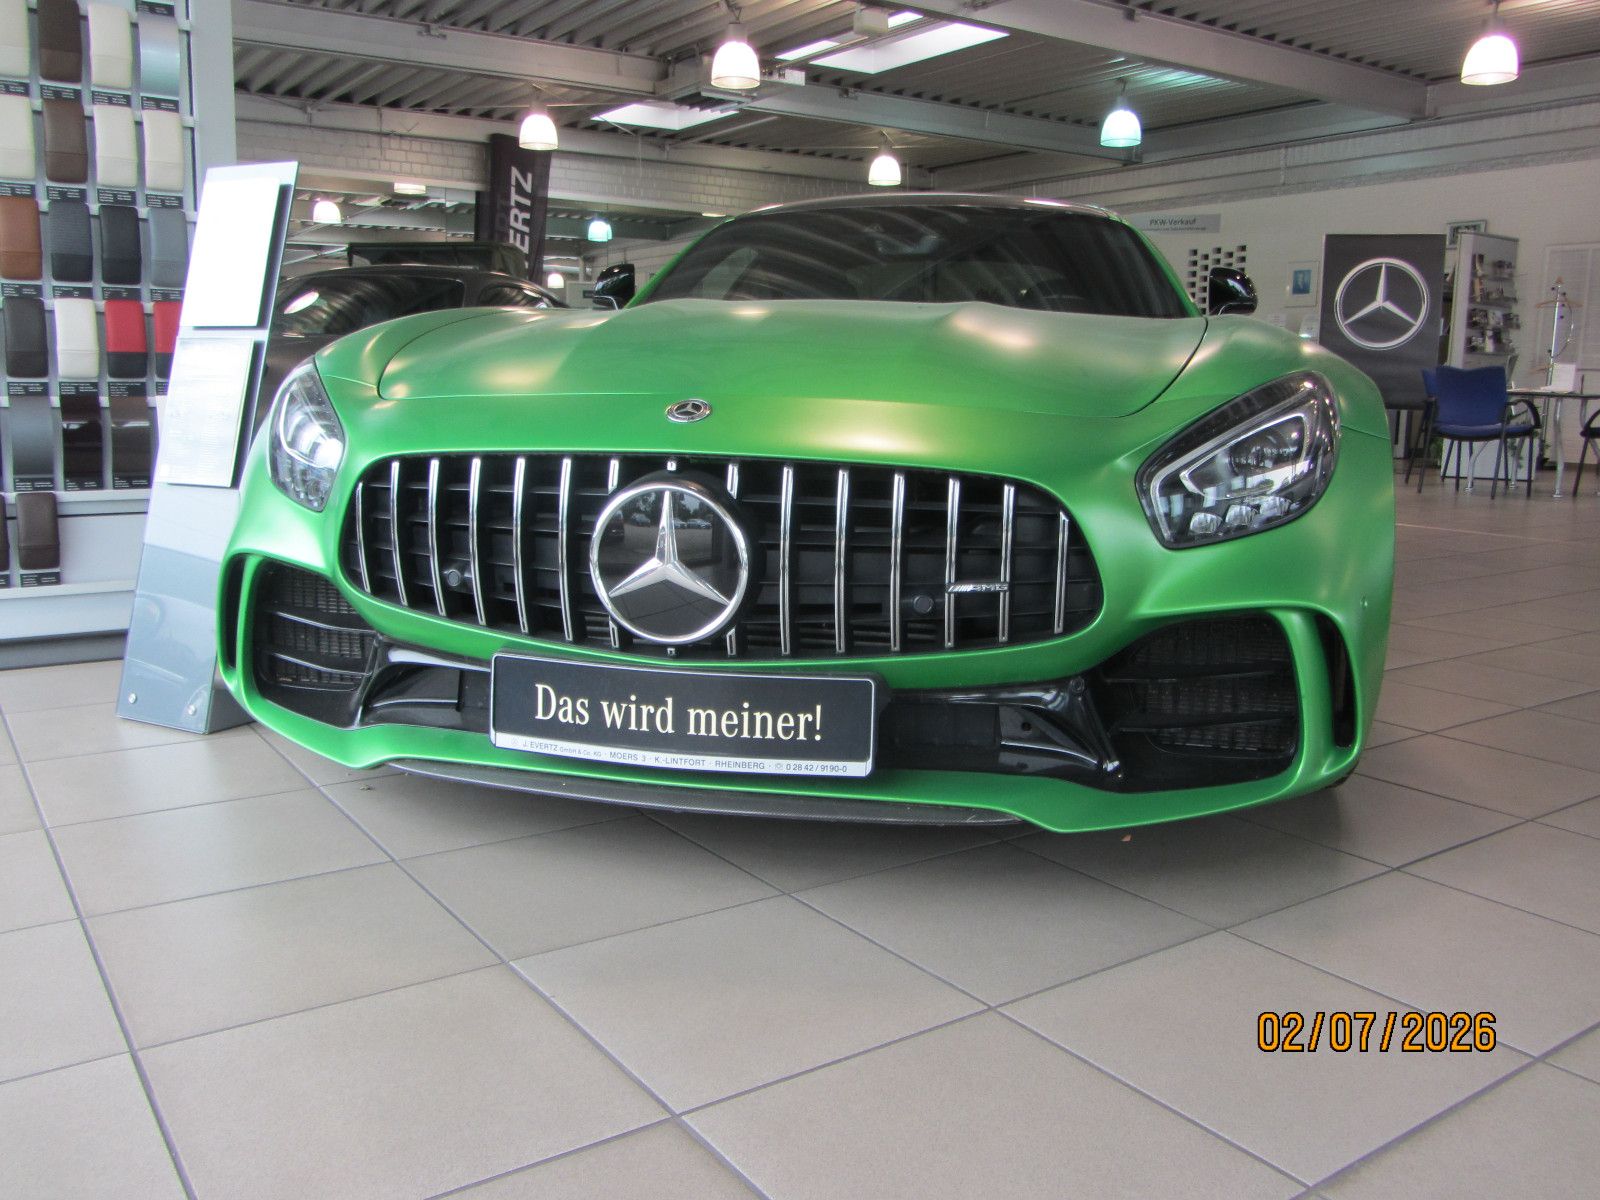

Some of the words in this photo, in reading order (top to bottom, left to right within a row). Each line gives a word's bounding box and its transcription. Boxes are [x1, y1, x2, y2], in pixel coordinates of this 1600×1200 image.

[509, 165, 533, 269] ERTZ
[535, 683, 590, 725] Das
[601, 695, 675, 734] wird
[687, 702, 822, 741] meiner!
[530, 741, 558, 752] EVERTZ
[609, 751, 639, 761] MOERS
[715, 760, 765, 770] RHEINBERG
